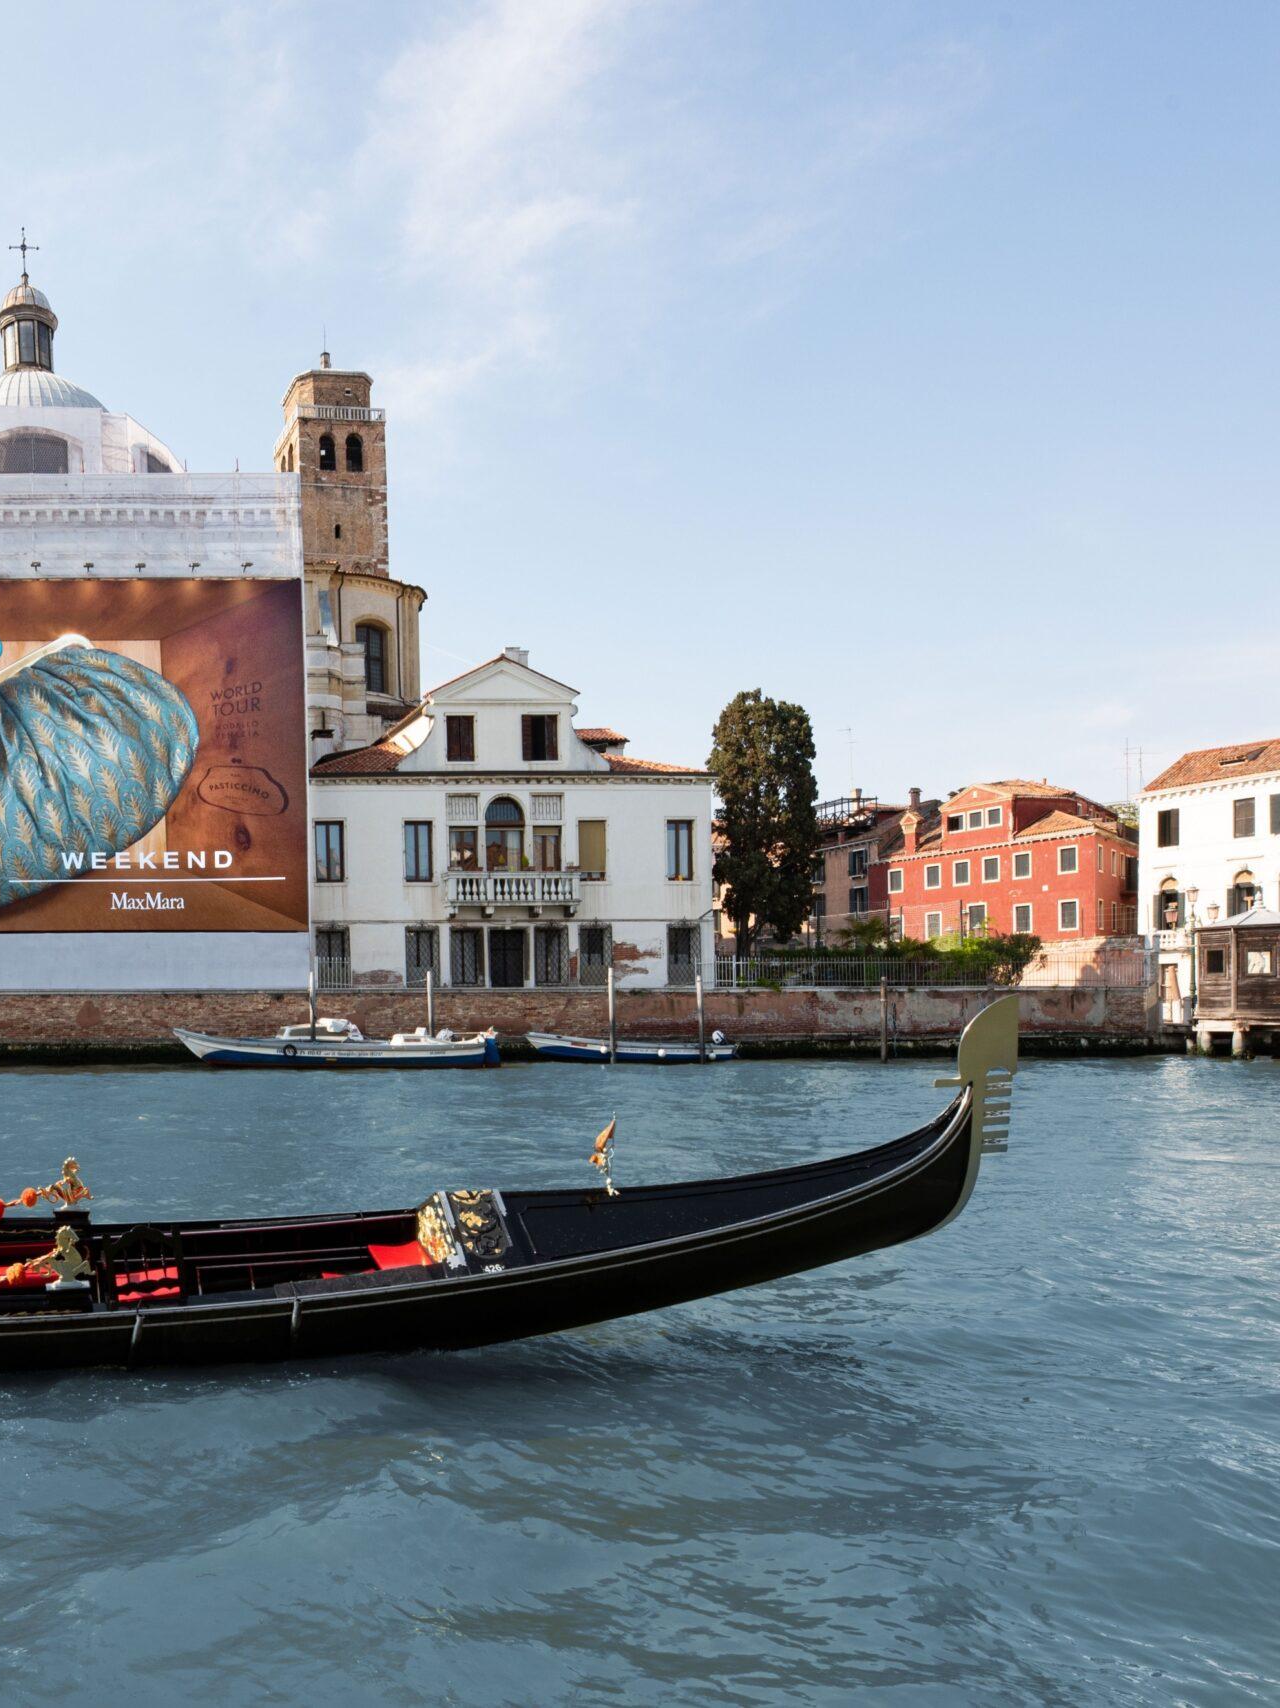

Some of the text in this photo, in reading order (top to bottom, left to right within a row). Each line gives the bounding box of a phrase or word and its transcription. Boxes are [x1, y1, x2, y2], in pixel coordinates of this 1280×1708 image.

[210, 681, 262, 701] WORLD
[212, 697, 261, 717] TOUR
[208, 782, 270, 799] PASTICCINO
[61, 850, 233, 870] WEEKEND
[110, 891, 185, 911] MaxMara
[484, 1264, 503, 1275] 426
